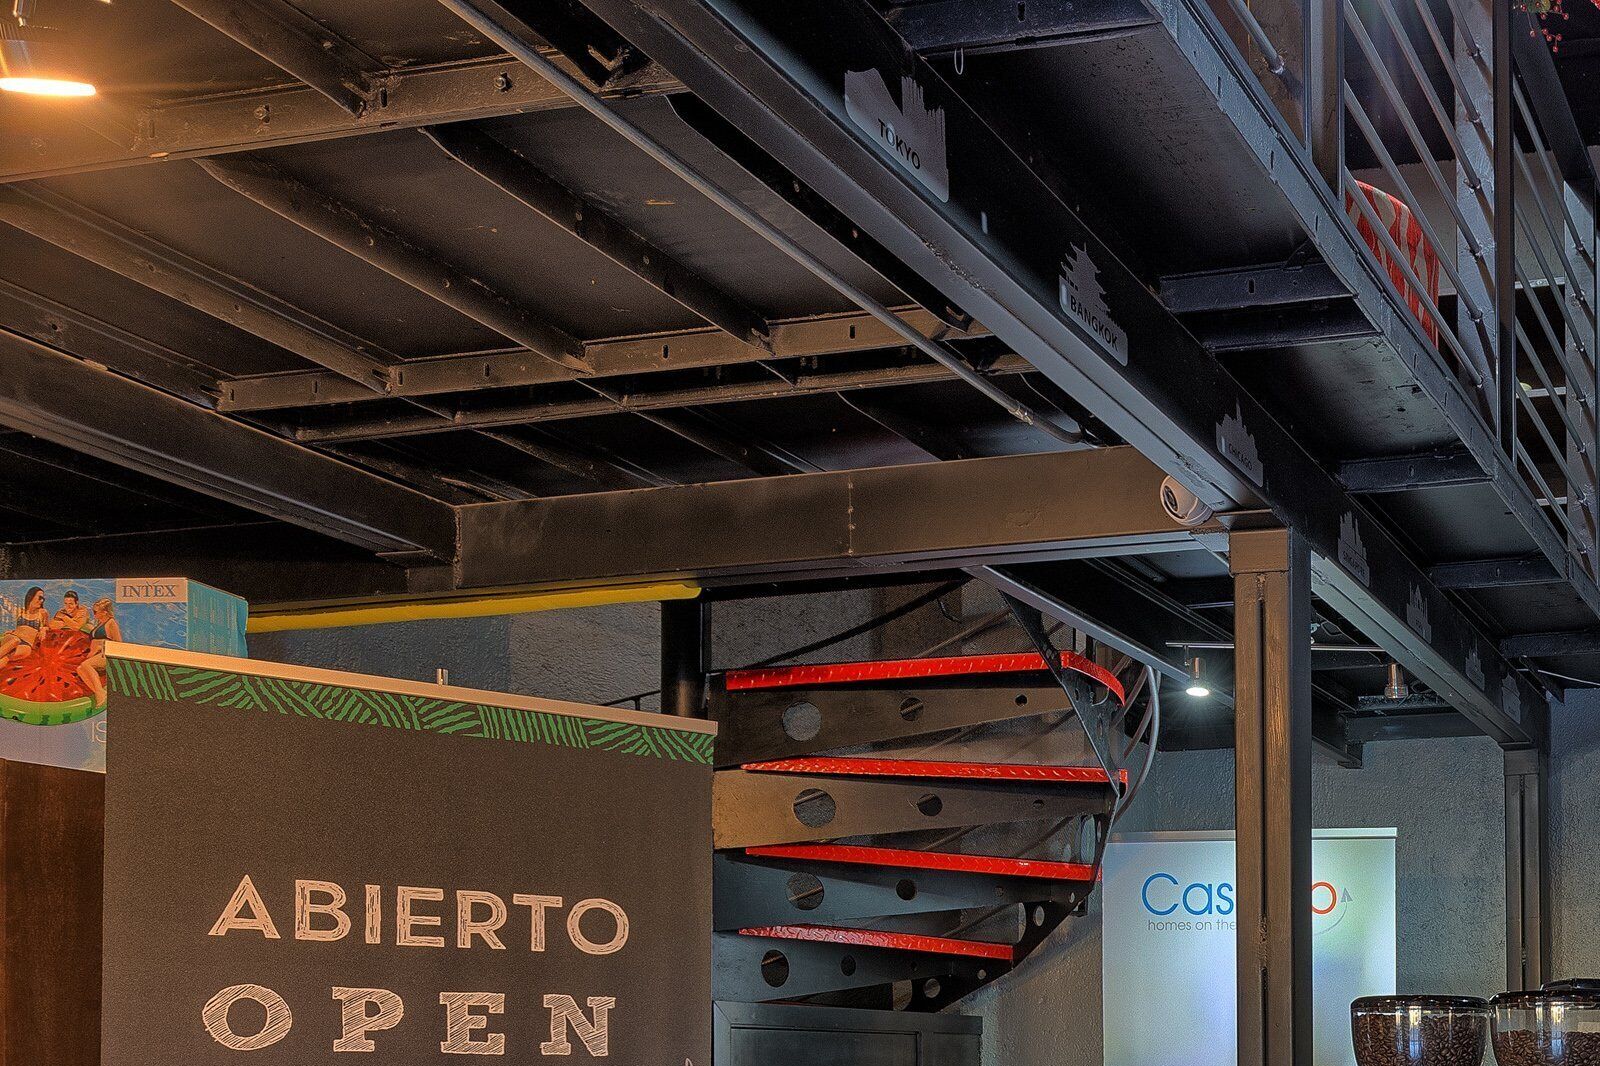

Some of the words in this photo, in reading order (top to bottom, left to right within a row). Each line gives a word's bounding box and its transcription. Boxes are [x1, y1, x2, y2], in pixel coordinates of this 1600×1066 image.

[877, 117, 921, 170] TOKYO
[1069, 295, 1119, 348] BANGKOK
[122, 584, 177, 598] INTEX
[207, 873, 630, 955] ABIERTO
[1147, 919, 1192, 931] homes
[1195, 920, 1211, 931] on
[201, 983, 617, 1058] OPEN
